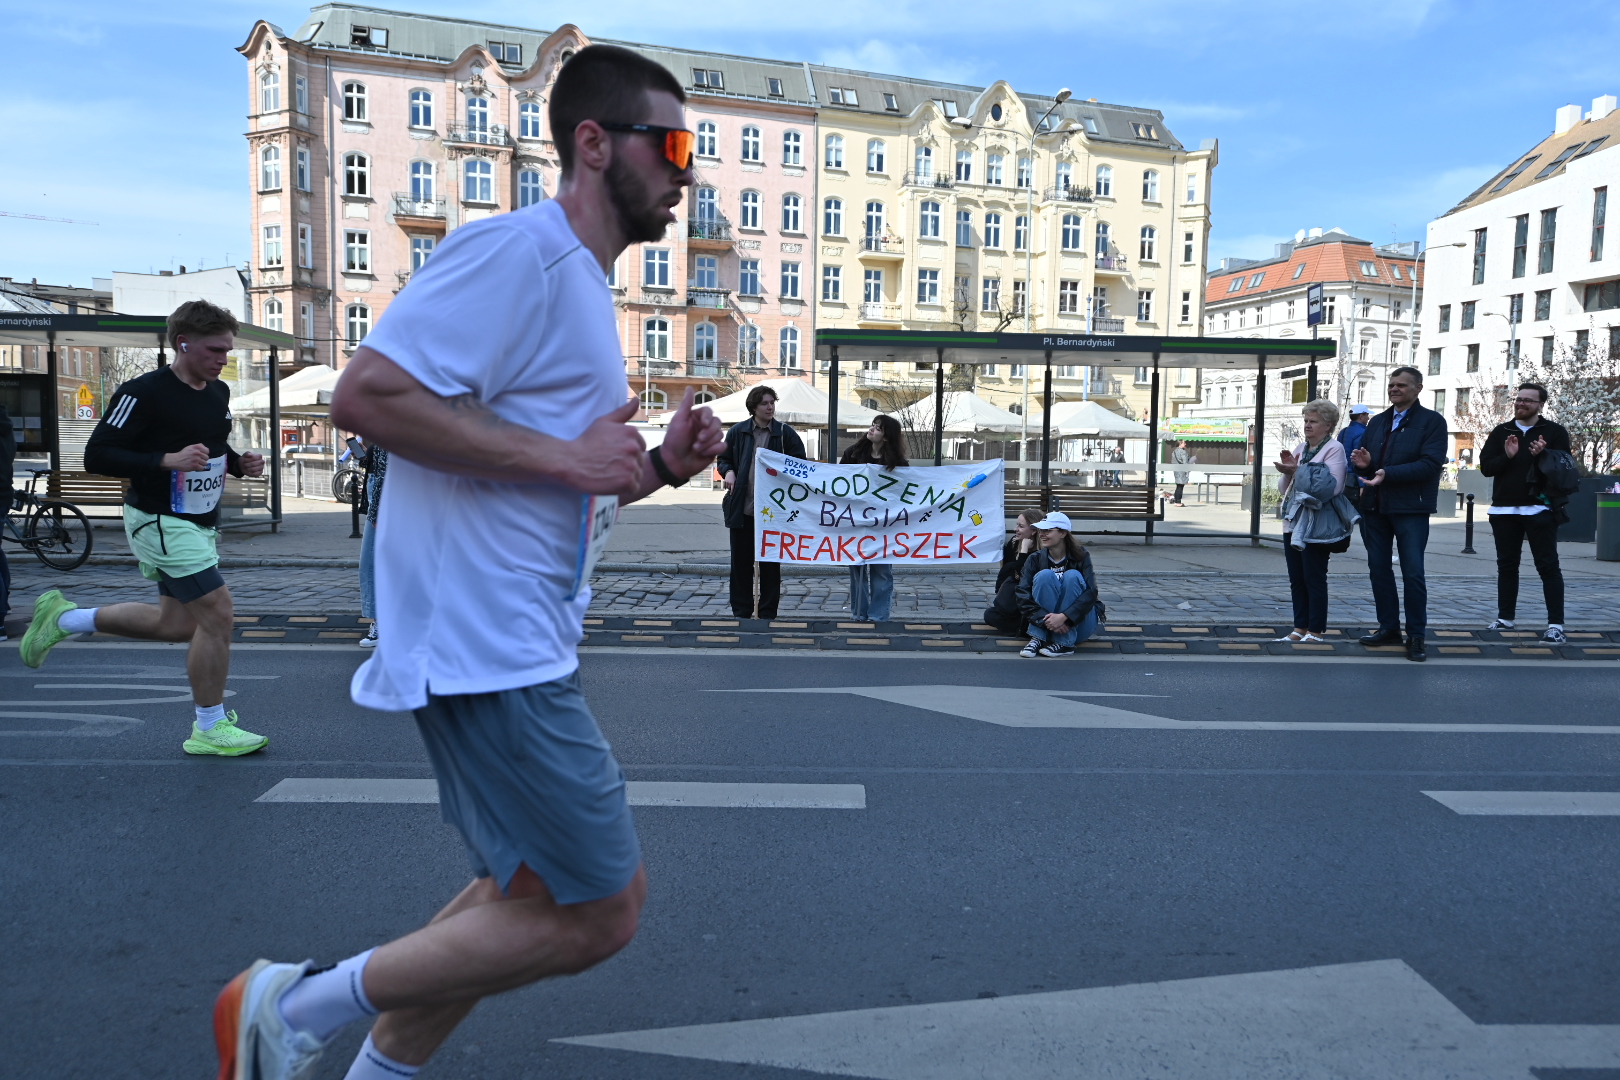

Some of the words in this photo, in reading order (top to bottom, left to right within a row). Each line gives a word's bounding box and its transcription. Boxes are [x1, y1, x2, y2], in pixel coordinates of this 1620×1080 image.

[0, 317, 52, 327] ernardyński
[1043, 337, 1055, 345] Pl.
[1057, 337, 1115, 347] Bernardyński
[78, 408, 93, 418] 30
[784, 457, 816, 473] POZNAŃ
[782, 467, 809, 479] 2025
[769, 473, 966, 522] POWODZENIA
[819, 500, 909, 528] BASIA
[760, 529, 978, 562] FREAKCISZEK
